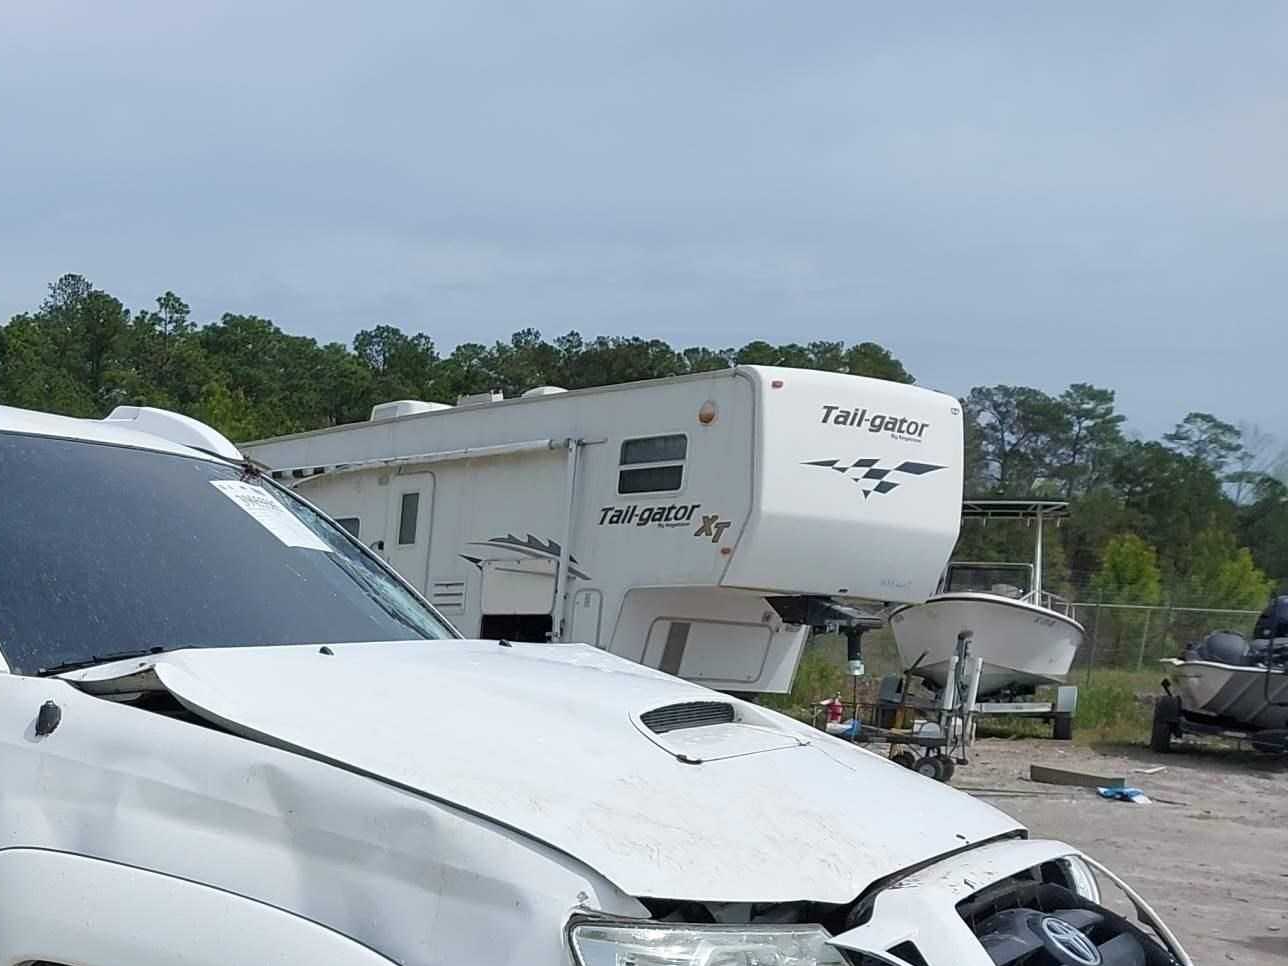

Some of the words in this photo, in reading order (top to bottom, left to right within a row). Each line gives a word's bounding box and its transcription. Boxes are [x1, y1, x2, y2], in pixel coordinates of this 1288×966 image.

[820, 405, 930, 438] Tail-gator
[598, 504, 701, 527] Tail-gator
[694, 515, 731, 543] XT
